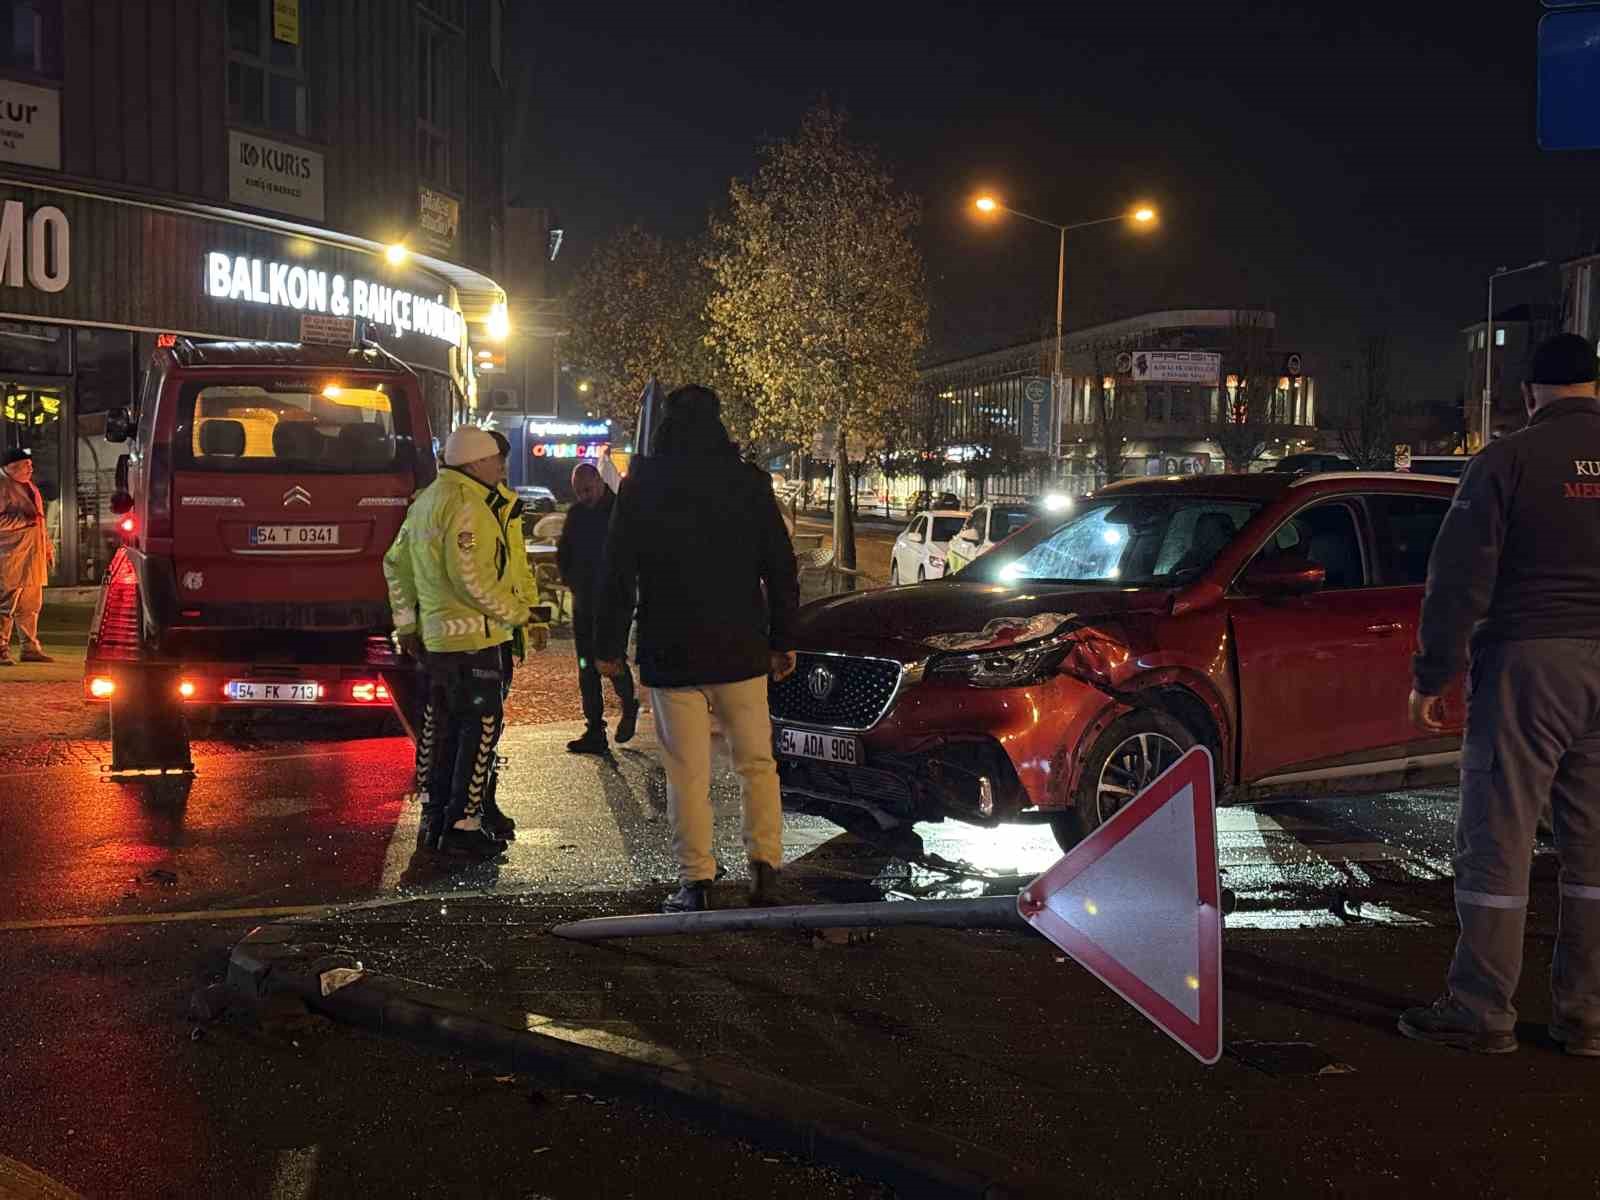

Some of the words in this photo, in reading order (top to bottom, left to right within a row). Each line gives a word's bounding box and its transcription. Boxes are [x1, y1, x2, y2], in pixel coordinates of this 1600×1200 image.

[204, 252, 326, 313] BALKON
[330, 274, 349, 318] &
[353, 279, 411, 338] BAHÇE
[258, 529, 275, 542] 54
[284, 529, 290, 542] T
[299, 528, 332, 542] 0341
[239, 685, 254, 698] 54
[265, 686, 280, 699] FK
[291, 686, 314, 700] 713
[781, 731, 796, 753] 54
[803, 735, 825, 758] ADA
[831, 738, 854, 761] 906
